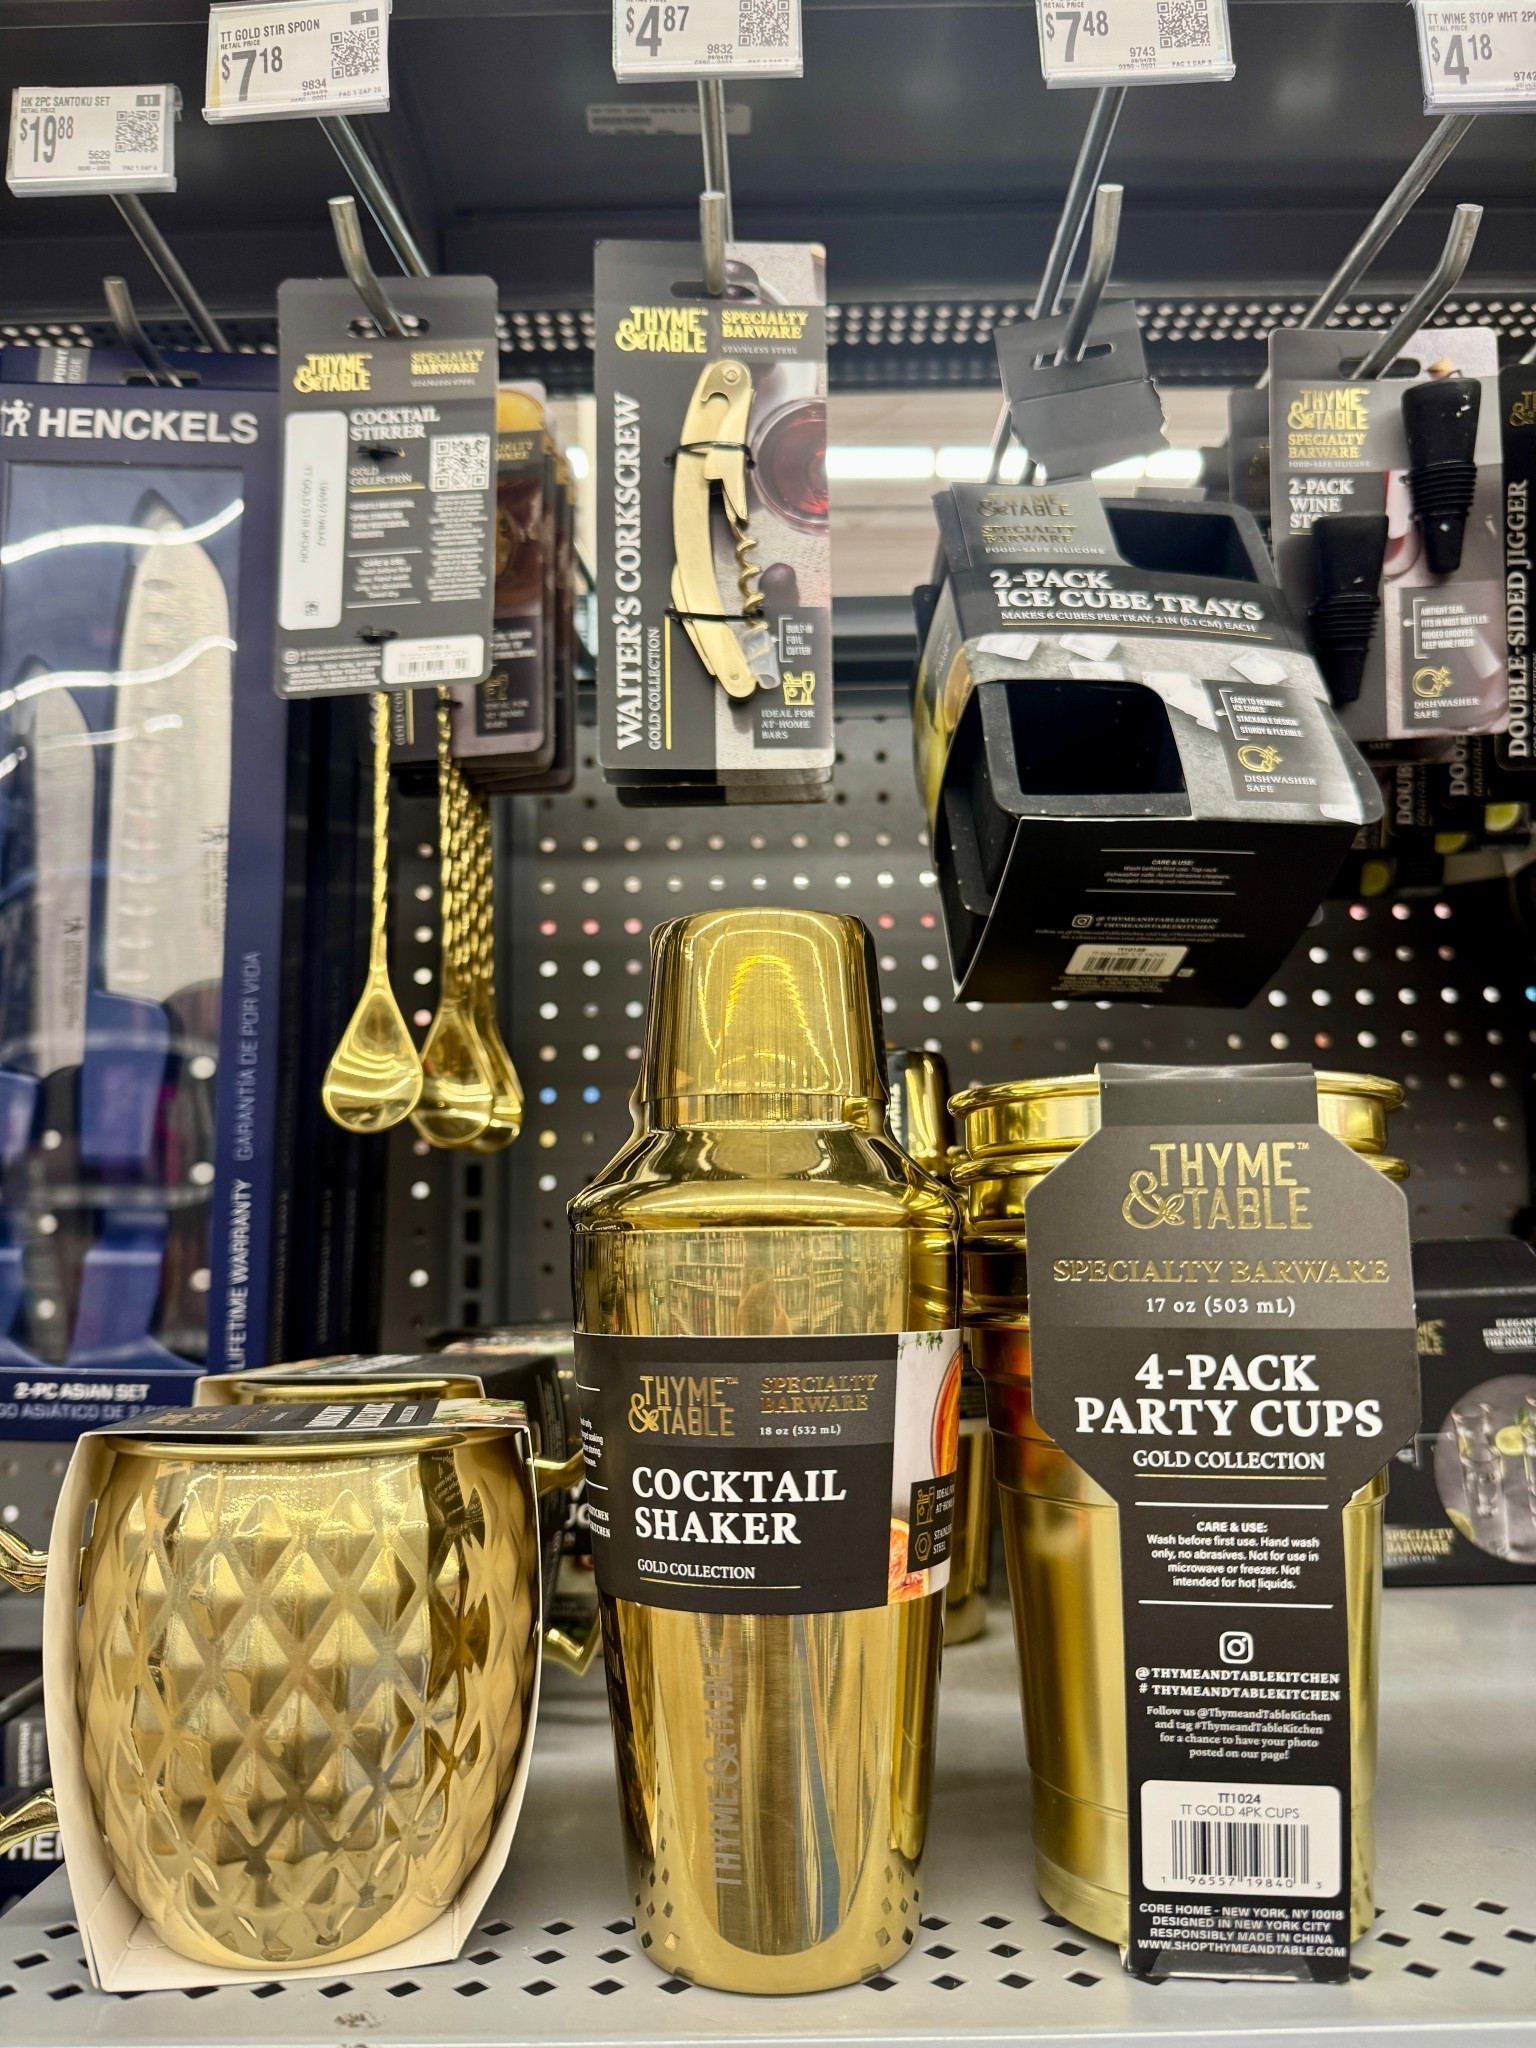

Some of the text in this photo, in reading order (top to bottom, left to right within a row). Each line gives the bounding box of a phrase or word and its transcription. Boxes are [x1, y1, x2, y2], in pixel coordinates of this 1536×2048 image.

[1427, 12, 1518, 24] TT WINE STOP WHT
[220, 19, 321, 43] TT GOLD STIR SPOON
[707, 44, 733, 54] 9832
[1129, 47, 1156, 58] 9743
[302, 78, 327, 90] 9834
[21, 96, 111, 107] HK 2PC SANTOKU SET
[88, 151, 111, 160] 5629
[721, 310, 808, 326] SPECIALTY
[721, 325, 803, 339] BARWARE
[349, 405, 440, 424] COCKTAIL
[37, 406, 259, 445] HENCKELS
[349, 424, 426, 441] STIRRER
[1288, 433, 1367, 446] SPECIALTY
[1288, 446, 1362, 459] BARWARE
[613, 390, 643, 593] CORKSCREW
[1288, 478, 1355, 495] 2-PACK
[1288, 496, 1343, 513] WINE
[980, 526, 1078, 535] SPECIALTY
[982, 534, 1074, 544] BARWARE
[989, 568, 1113, 589] 2-PACK
[994, 587, 1265, 622] ICE CUBE TRAYS
[1001, 611, 1046, 620] MAKES
[1046, 612, 1054, 620] 6
[1055, 611, 1096, 621] CUBES
[1096, 613, 1119, 622] PER
[1120, 614, 1155, 625] TRAY,
[1165, 616, 1178, 625] IN
[1224, 620, 1257, 633] EACH
[1507, 479, 1532, 758] DOUBLE-SIDED JIGGER
[647, 627, 662, 750] GOLD COLLECTION
[761, 709, 815, 718] IDEAL FOR
[761, 720, 811, 729] AT-HOME
[761, 730, 789, 740] BARS
[1243, 774, 1318, 786] DISHWASHER
[1245, 784, 1275, 794] SAFE
[226, 1178, 252, 1286] WARRANTY
[1053, 1259, 1390, 1284] SPECIALTY BARWARE
[1146, 1295, 1296, 1318] 17 oz (503 mL)
[224, 1287, 249, 1373] LIFETIME
[1134, 1353, 1320, 1392] 4-PACK
[13, 1382, 150, 1401] 2-PC ASIAN SET
[760, 1374, 878, 1394] SPECIALTY
[760, 1394, 868, 1414] BARWARE
[1074, 1397, 1384, 1438] PARTY CUPS
[759, 1423, 841, 1437] 18 oz (532 mL)
[1133, 1449, 1326, 1470] GOLD COLLECTION
[632, 1466, 847, 1503] COCKTAIL
[634, 1506, 802, 1545] SHAKER
[1196, 1522, 1268, 1533] CARE & USE:
[1384, 1528, 1454, 1540] SPECIALTY
[1147, 1534, 1320, 1548] Wash before first use. Hand wash
[1385, 1541, 1450, 1554] BARWARE
[1151, 1548, 1319, 1562] only, no abrasives. Not for use in
[637, 1558, 756, 1580] GOLD COLLECTION
[1168, 1562, 1301, 1575] microwave or freezer. Not
[1173, 1576, 1297, 1590] intended for hot liquids.
[701, 1647, 736, 1738] TABLE
[1217, 1792, 1261, 1804] TT1024
[1180, 1804, 1300, 1819] TT GOLD 4PK CUPS
[707, 1786, 743, 1886] THYME
[1139, 1903, 1344, 1921] CORE HOME NEW YORK, NY 10018
[1152, 1916, 1331, 1932] DESIGNED IN NEW YORK CITY
[1150, 1928, 1335, 1945] RESPONSIBLY MADE IN CHINA
[1138, 1938, 1345, 1958] WWW.SHOPTHYMEANDTABLE.COM
